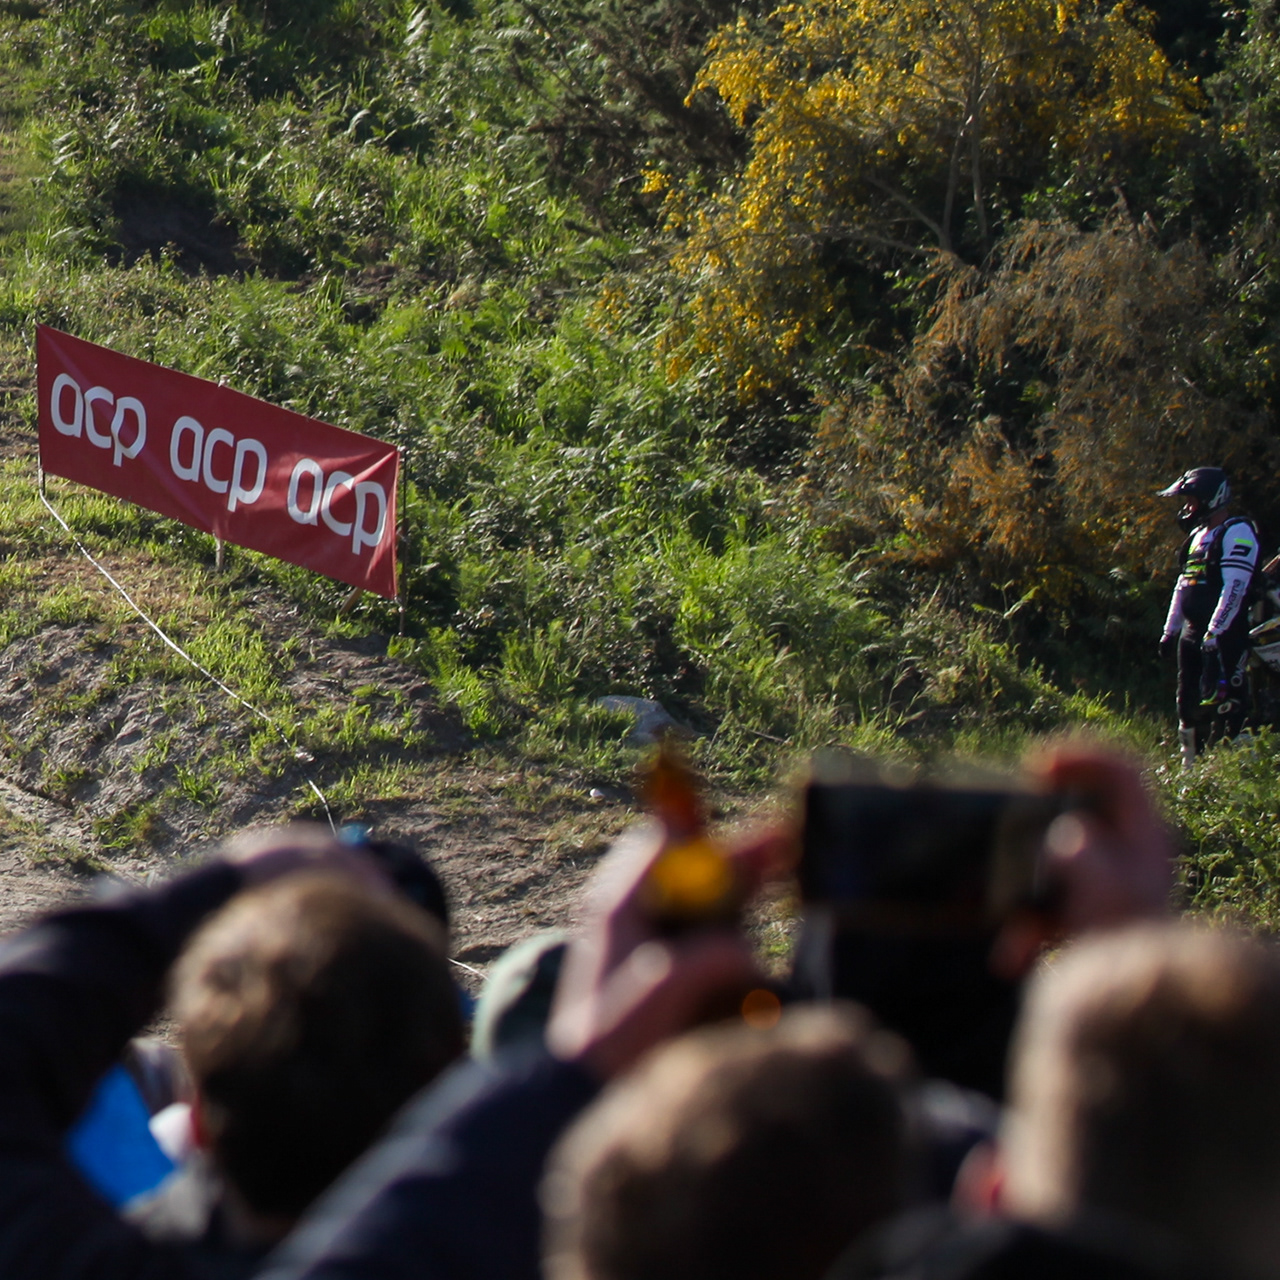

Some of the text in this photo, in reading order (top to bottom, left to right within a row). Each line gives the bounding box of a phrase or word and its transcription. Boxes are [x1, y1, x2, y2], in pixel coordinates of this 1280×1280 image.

[51, 373, 388, 555] acp acp acp
